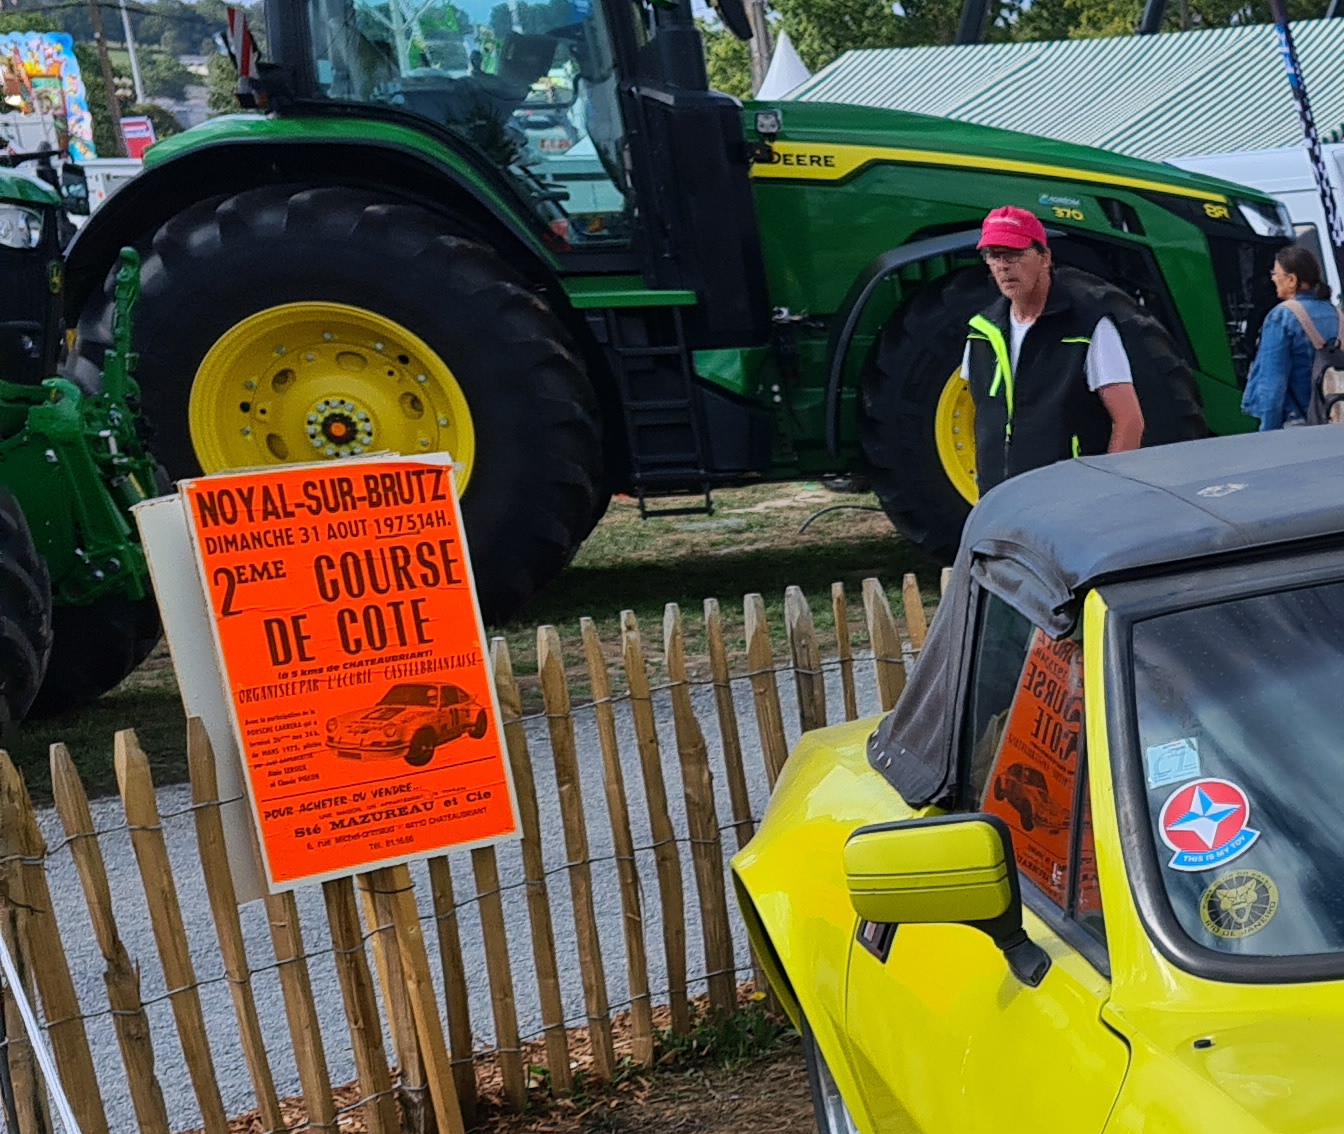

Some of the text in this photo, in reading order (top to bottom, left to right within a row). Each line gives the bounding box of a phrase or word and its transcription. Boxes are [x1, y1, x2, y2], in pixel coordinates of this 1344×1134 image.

[770, 152, 836, 167] DEERE
[1203, 203, 1231, 219] 8R
[195, 468, 447, 528] NOYAL-SUR-BRUTZ
[204, 526, 296, 555] DIMANCHE
[300, 525, 321, 543] 31
[327, 519, 369, 541] AOUT
[374, 513, 418, 537] 1975
[314, 538, 463, 603] COURSE
[263, 597, 435, 667] DE COTE
[300, 667, 323, 676] kms
[326, 664, 340, 673] de
[263, 806, 294, 820] POUR
[299, 795, 348, 813] ACHETER
[353, 792, 367, 802] OU
[294, 791, 492, 838] Sté MAZUREAU et Cie
[1183, 834, 1246, 863] THIS IS MY TOY
[1205, 920, 1220, 934] RIO
[1244, 901, 1276, 934] JANEIRO
